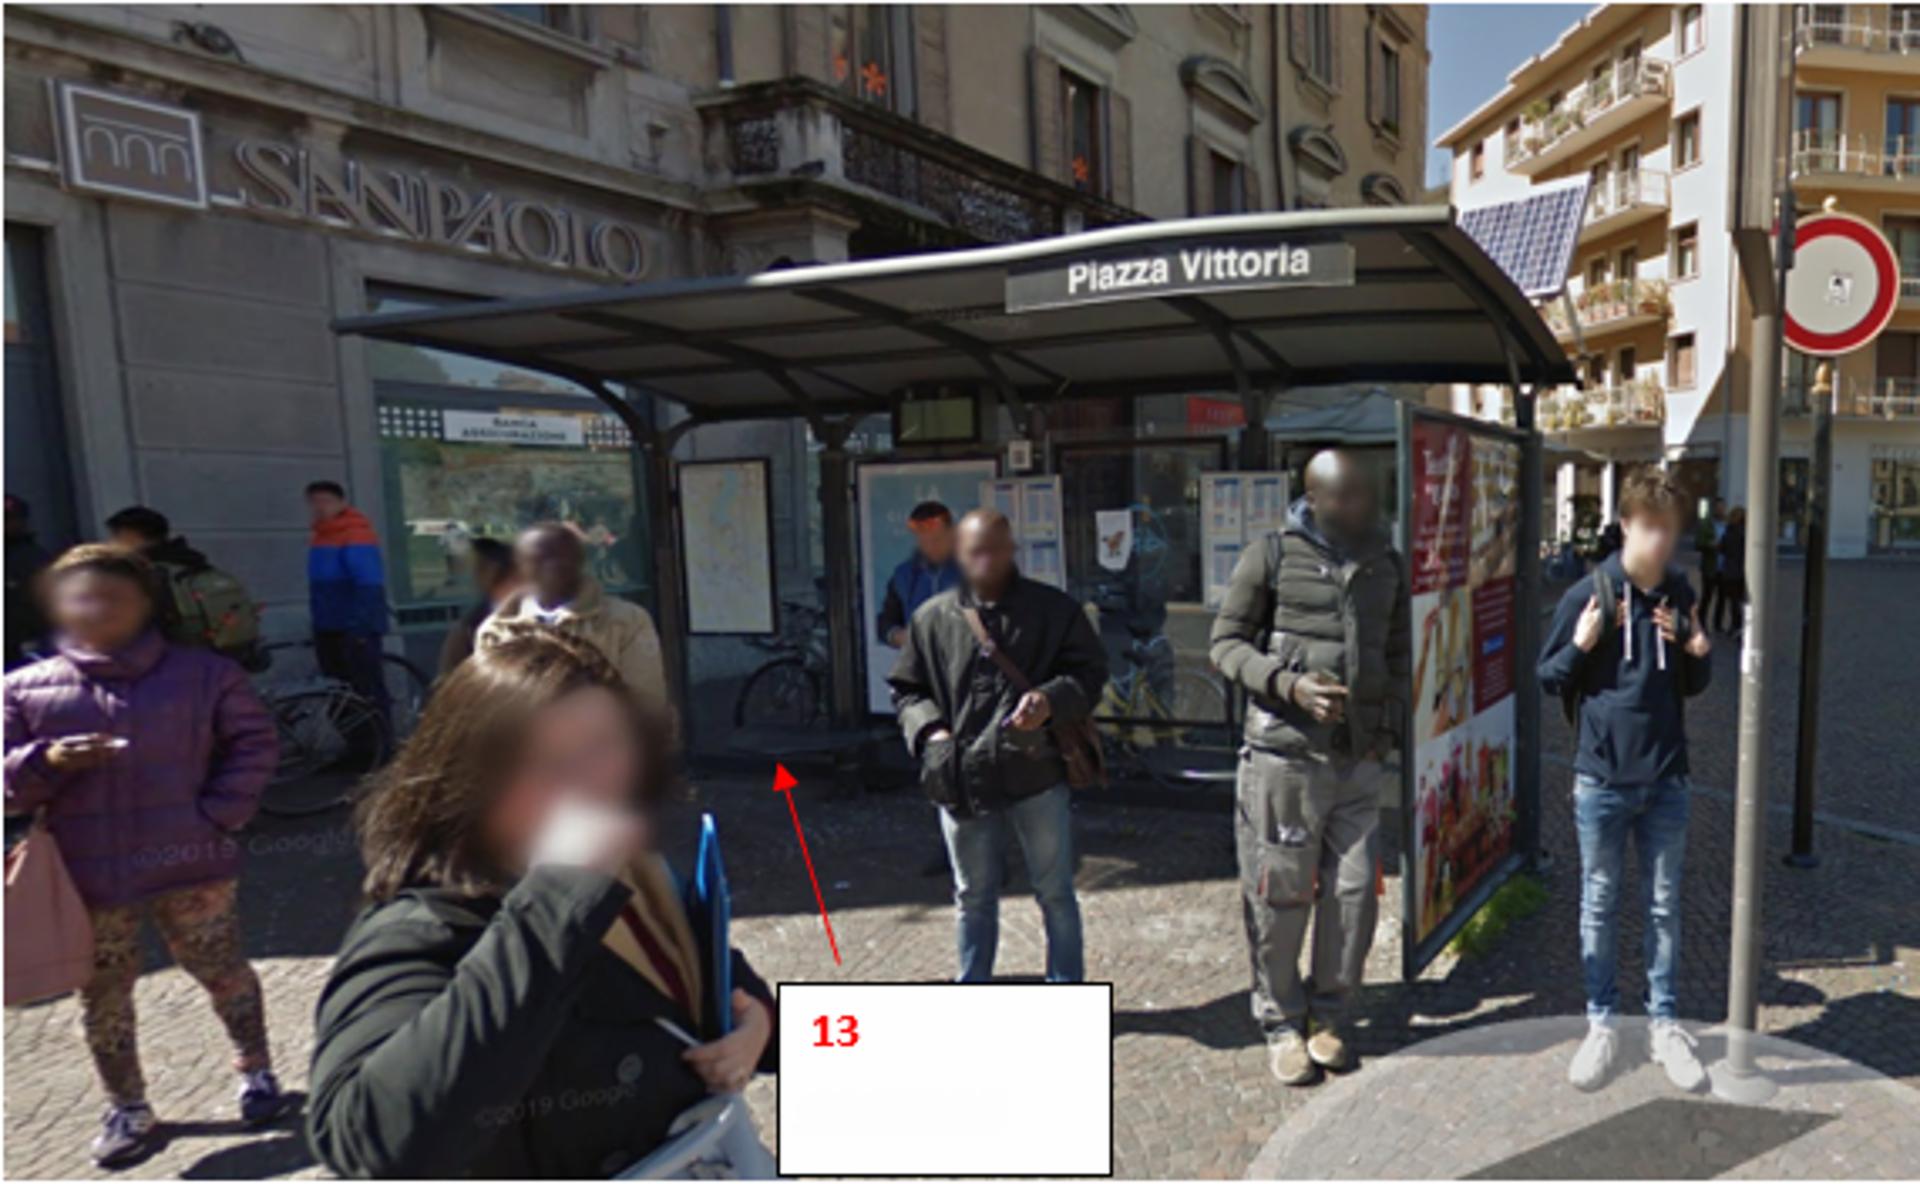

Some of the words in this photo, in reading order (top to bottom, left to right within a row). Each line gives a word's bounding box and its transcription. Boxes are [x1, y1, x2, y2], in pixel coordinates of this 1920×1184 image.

[233, 140, 649, 281] SANPAOLO
[1068, 257, 1168, 294] Piazza
[1180, 243, 1310, 281] Vittoria
